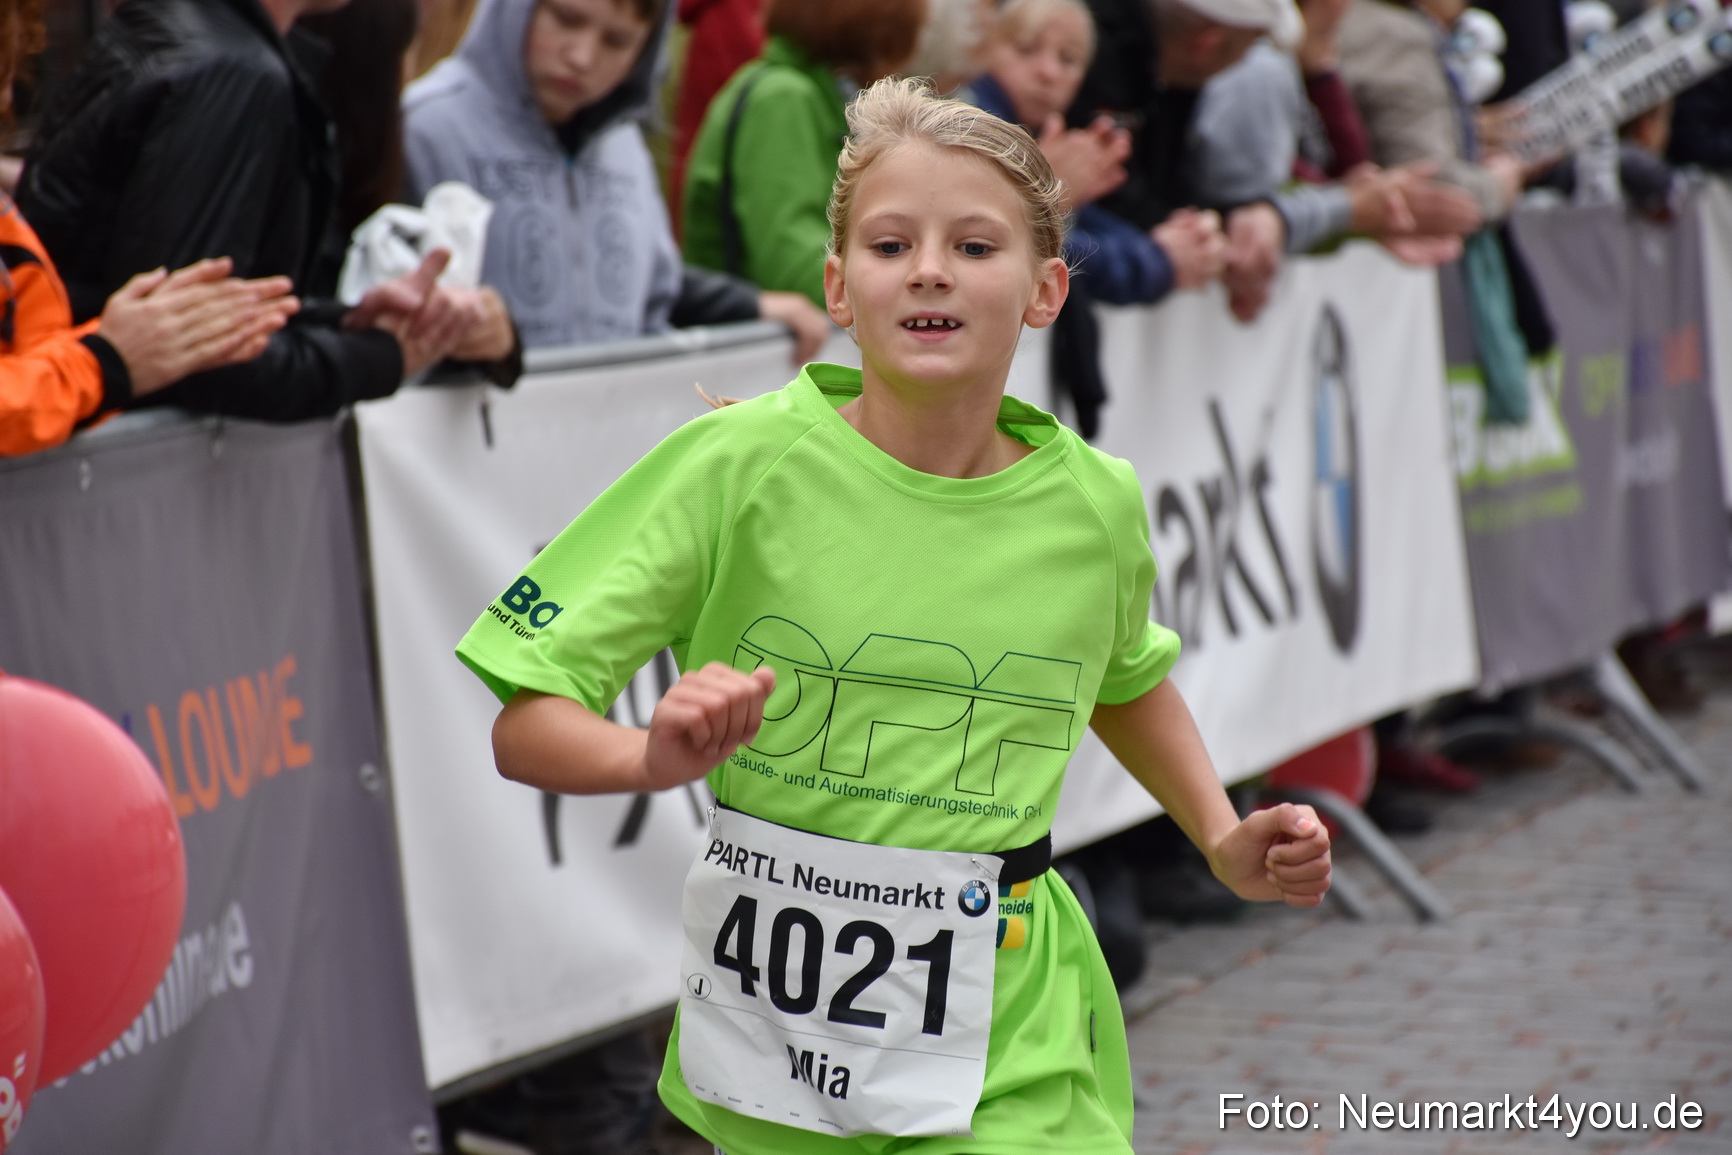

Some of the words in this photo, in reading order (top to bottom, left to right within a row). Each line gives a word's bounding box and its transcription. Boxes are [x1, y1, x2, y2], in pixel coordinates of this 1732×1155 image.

[487, 603, 511, 625] und
[783, 772, 815, 789] und
[818, 776, 1020, 820] Automatisierungstechnik
[704, 838, 785, 886] PARTL
[792, 862, 946, 911] Neumarkt
[694, 978, 704, 996] J
[713, 893, 955, 1037] 4021
[786, 1043, 851, 1101] Mia
